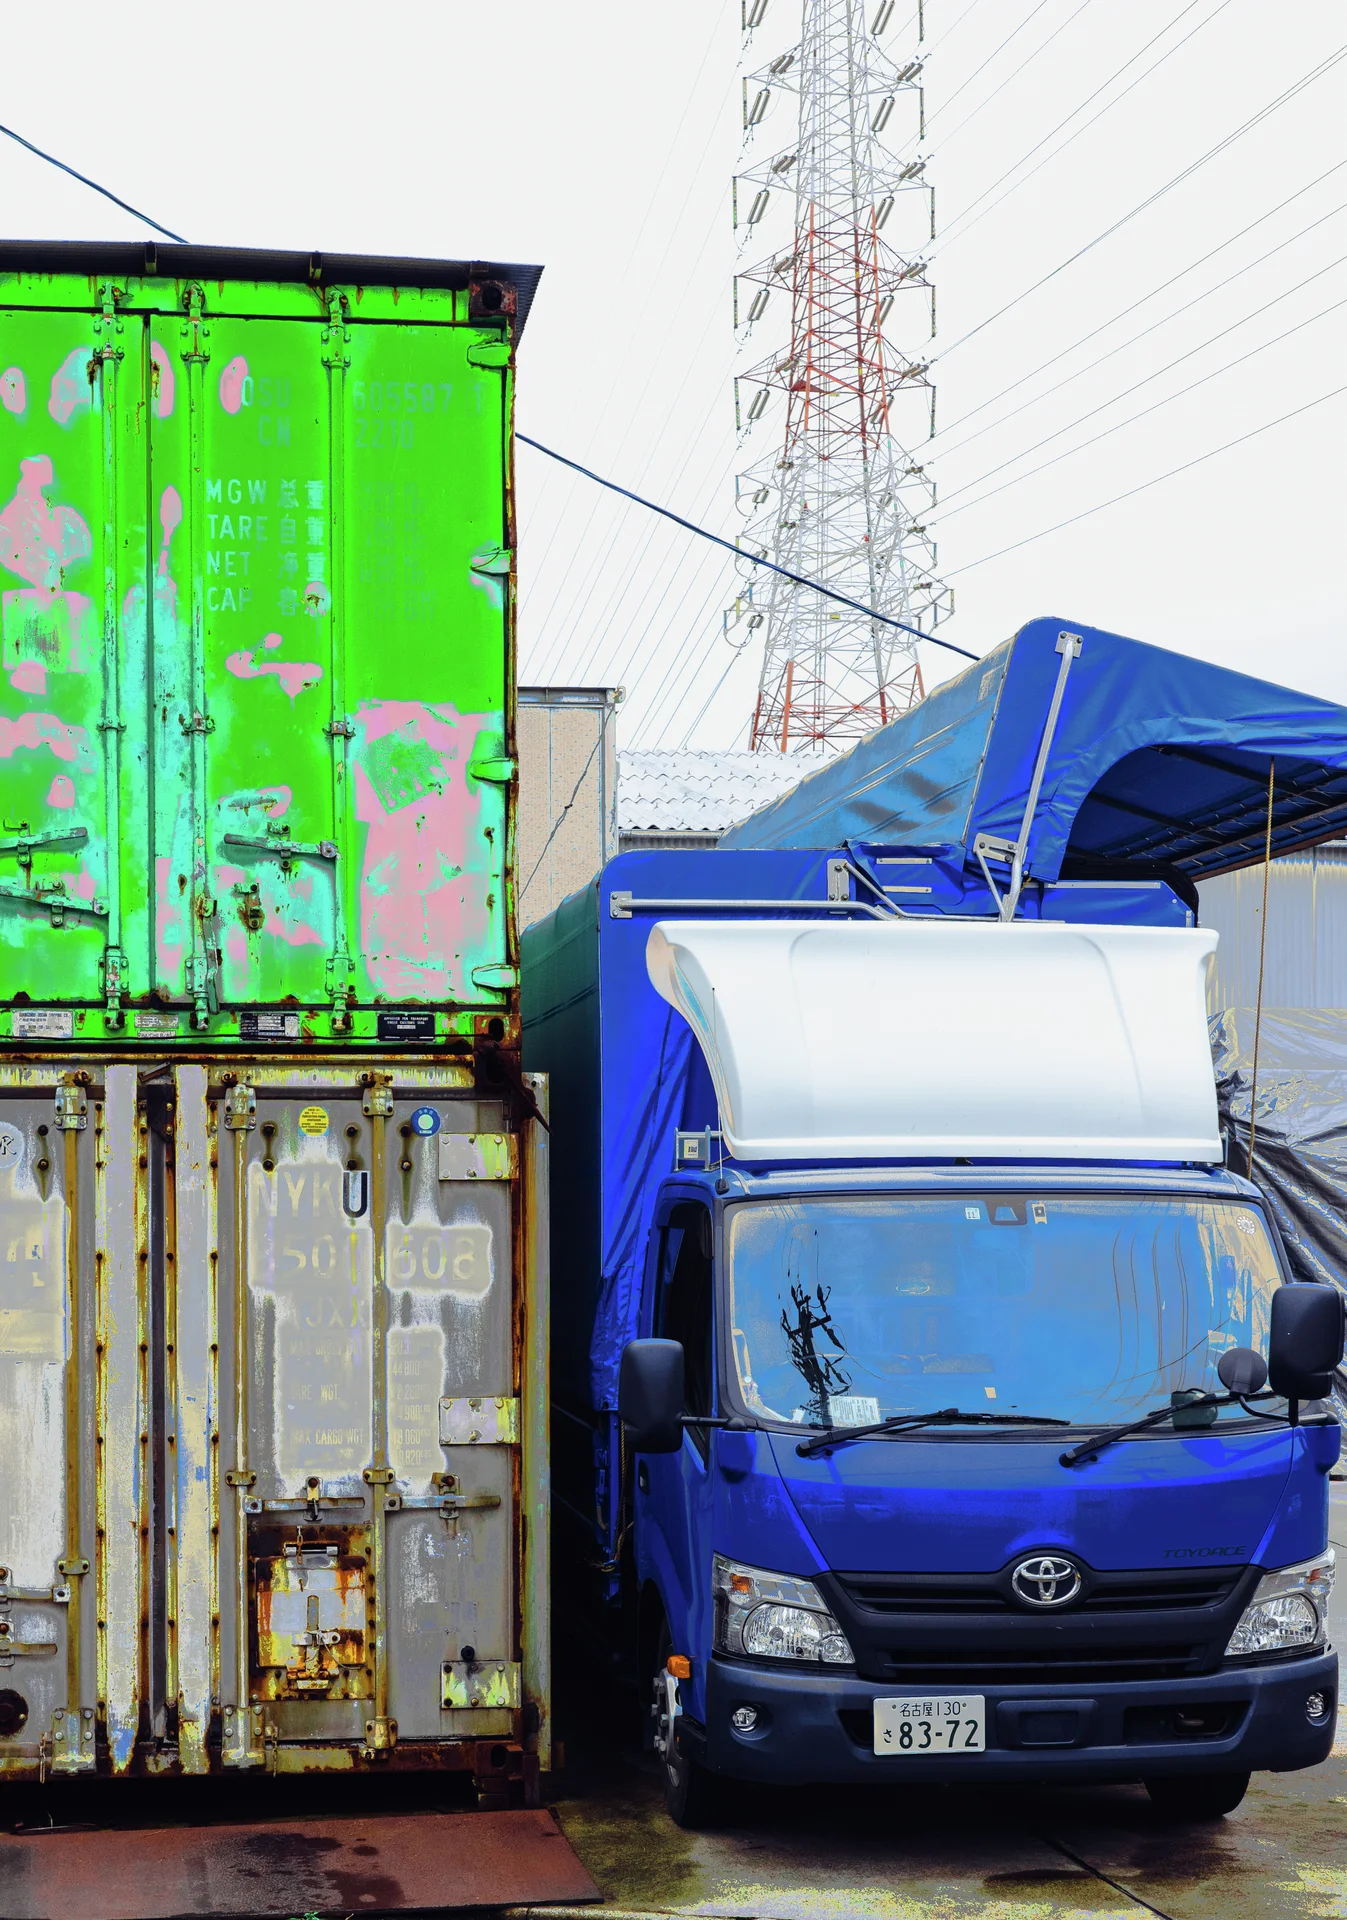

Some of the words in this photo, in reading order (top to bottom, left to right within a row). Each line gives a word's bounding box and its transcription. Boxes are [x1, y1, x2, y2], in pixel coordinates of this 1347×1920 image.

[222, 374, 291, 409] OSU
[353, 380, 453, 415] 605587
[258, 414, 291, 448] CN
[355, 418, 415, 450] 2210
[206, 478, 267, 505] MGW
[207, 514, 268, 541] TARE
[207, 551, 251, 577] NET
[207, 587, 252, 612] CAP
[900, 1702, 933, 1717] 名古屋
[936, 1701, 961, 1716] 130
[883, 1728, 892, 1744] さ
[899, 1719, 979, 1749] 83-72
